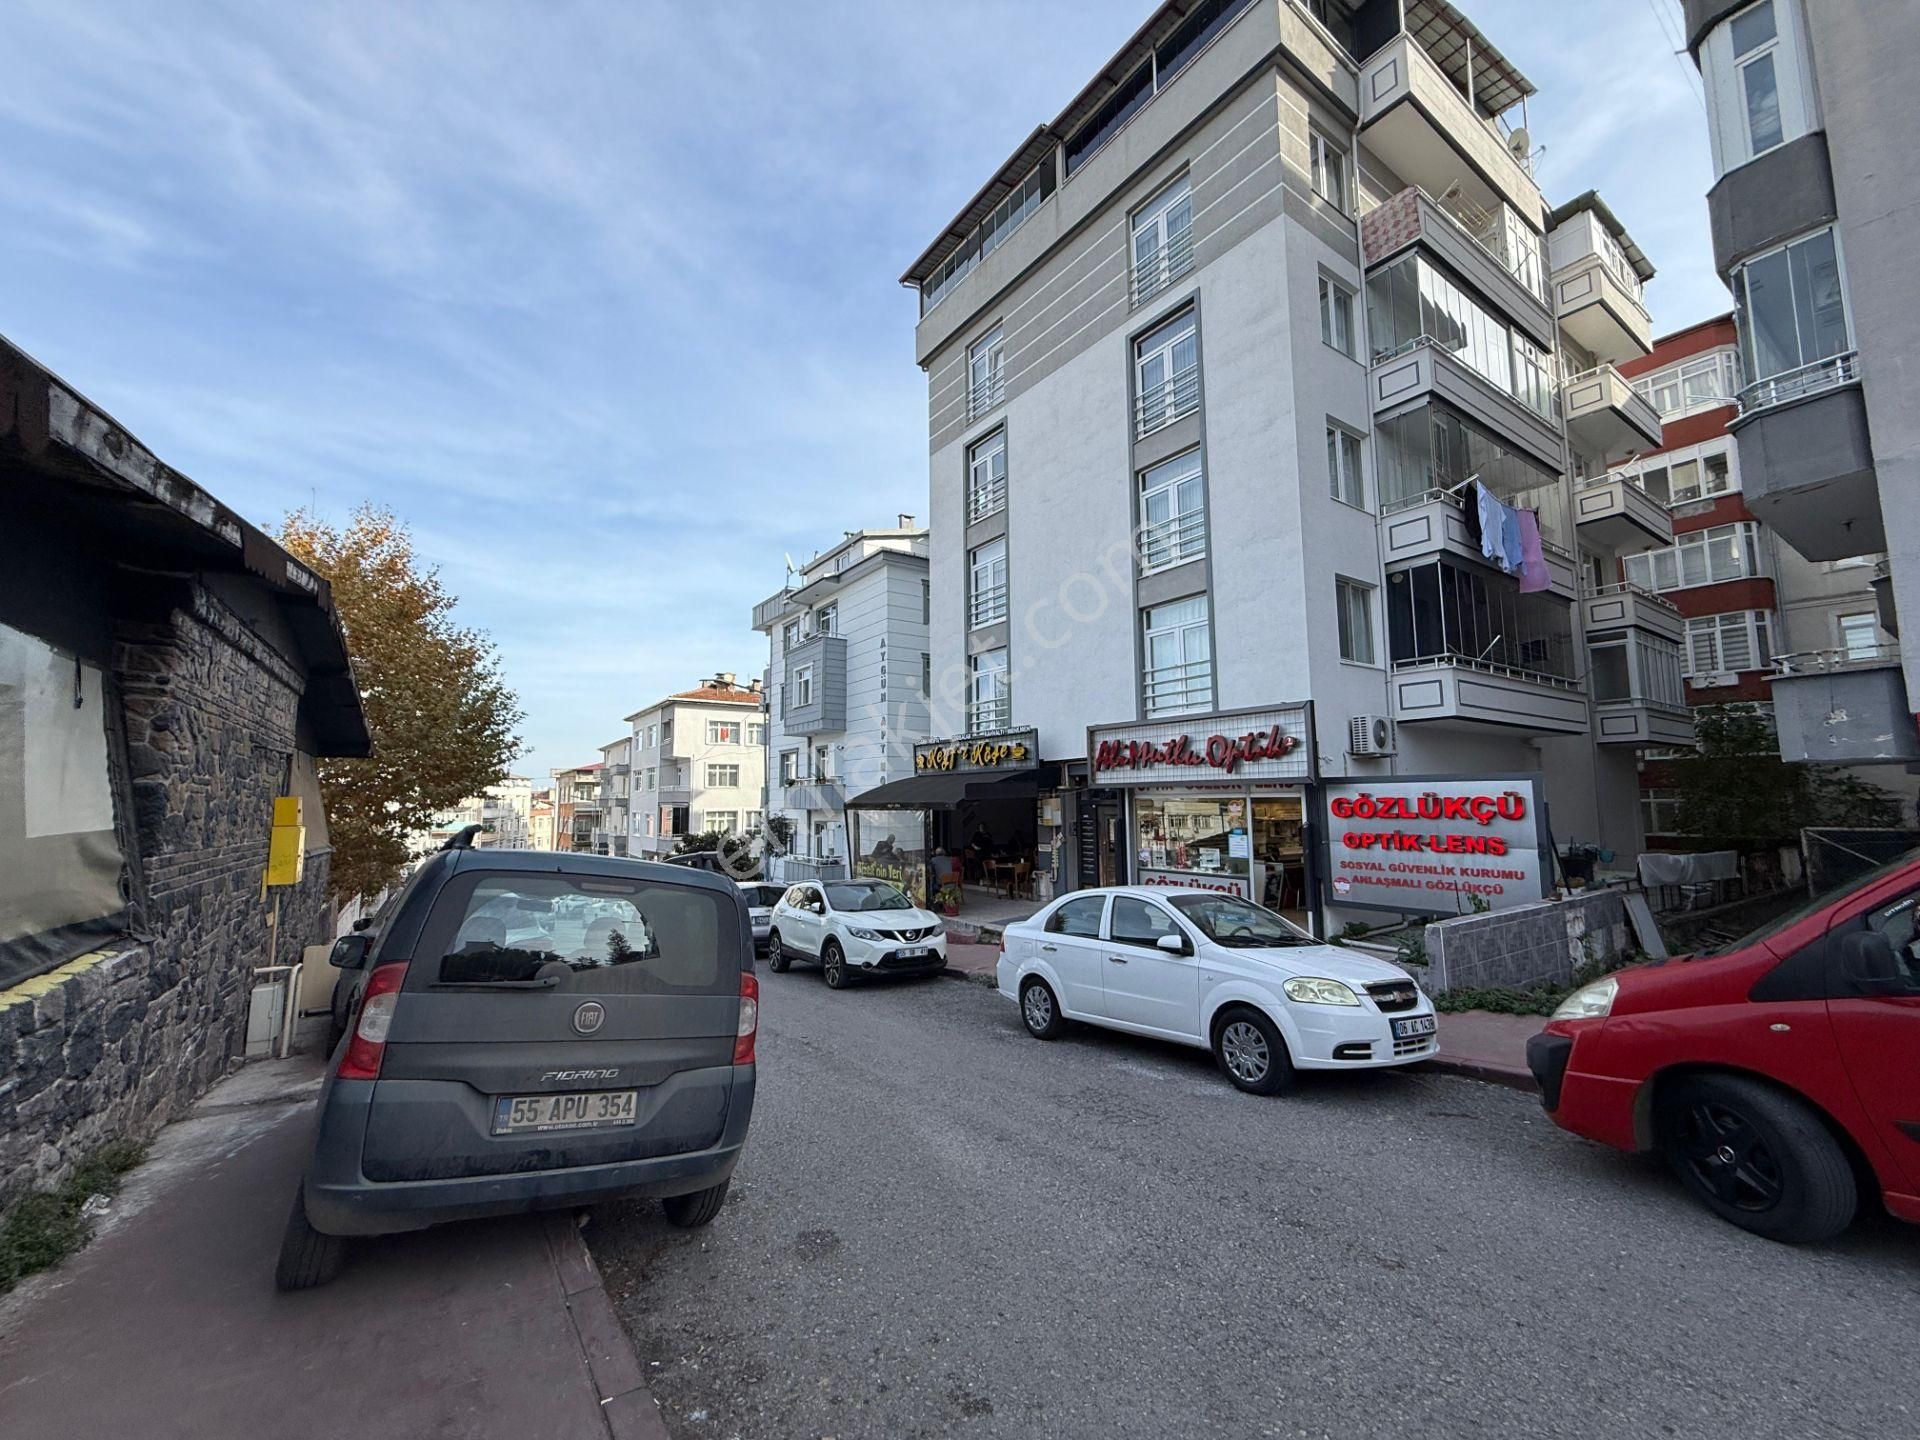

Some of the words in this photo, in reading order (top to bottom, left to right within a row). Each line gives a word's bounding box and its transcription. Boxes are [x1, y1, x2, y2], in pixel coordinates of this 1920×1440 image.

[1096, 738, 1129, 771] Ali
[1129, 734, 1204, 770] Mutlu
[1206, 724, 1291, 774] Optik
[1331, 792, 1525, 826] GÖZLÜKÇÜ
[1342, 830, 1507, 856] OPTİK-LENS
[887, 864, 903, 881] Yeri
[1340, 860, 1385, 871] SOSYAL
[1388, 863, 1456, 876] GÜVENLİK
[1460, 867, 1525, 880] KURUMU
[1352, 875, 1422, 888] ANLAŞMALI
[1425, 879, 1504, 896] GÖZLÜKÇÜ
[580, 1011, 599, 1025] FIAT
[1399, 1022, 1408, 1035] 06
[540, 1068, 620, 1082] FIORINO
[512, 1099, 539, 1124] 55
[548, 1096, 589, 1121] APU
[597, 1094, 633, 1118] 354
